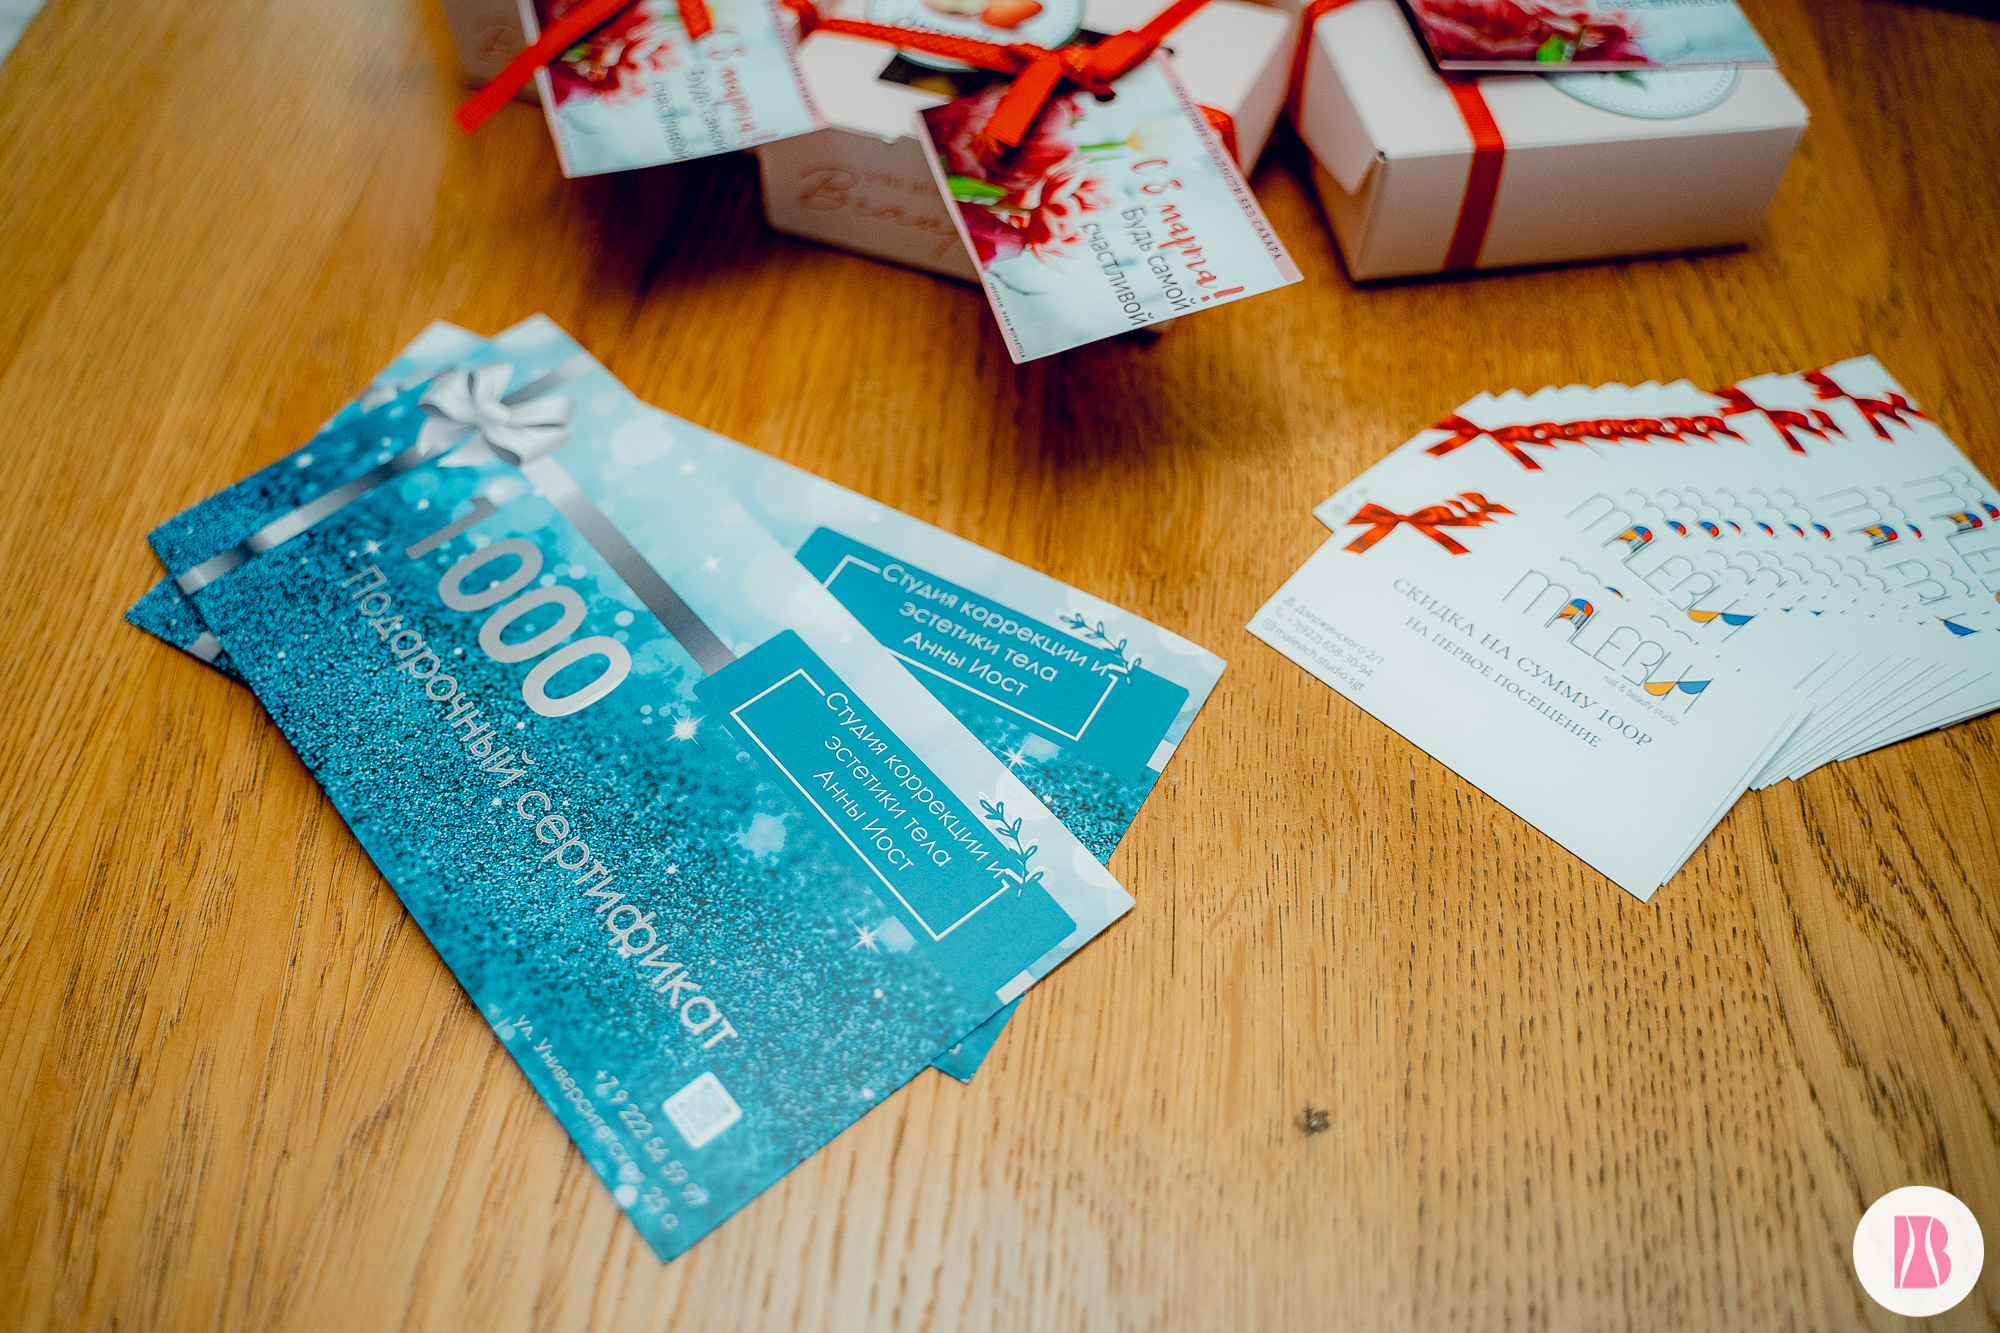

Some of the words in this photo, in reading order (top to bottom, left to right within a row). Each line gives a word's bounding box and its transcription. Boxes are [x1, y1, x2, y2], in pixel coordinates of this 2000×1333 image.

[1141, 179, 1183, 194] 8
[1081, 222, 1155, 327] счастливой
[1121, 206, 1156, 252] Будь
[1147, 255, 1197, 312] самой
[405, 497, 632, 718] 1000
[882, 563, 958, 607] Студия
[959, 600, 1089, 667] коррекции
[898, 600, 999, 656] эстетики
[1003, 646, 1058, 683] тела
[1321, 639, 1373, 677] 658-30-94
[1393, 577, 1476, 638] СКИДКА
[1480, 632, 1512, 660] НА
[1517, 656, 1598, 711] СУММУ
[903, 632, 966, 668] Анны
[968, 661, 1029, 697] Иост
[1405, 615, 1429, 638] НА
[1432, 632, 1493, 678] ПЕРВОЕ
[1494, 673, 1602, 748] ПОСЕЩЕНИЕ
[1624, 685, 1653, 710] beauty
[1653, 704, 1679, 727] studio
[342, 564, 535, 788] Подарочный
[517, 790, 739, 1049] сертификат
[813, 769, 863, 822] Анны
[861, 817, 914, 872] Иост
[824, 735, 907, 820] эстетики
[903, 816, 952, 868] тела
[826, 691, 888, 756] Студия
[884, 751, 989, 861] коррекции
[986, 860, 1005, 879] и
